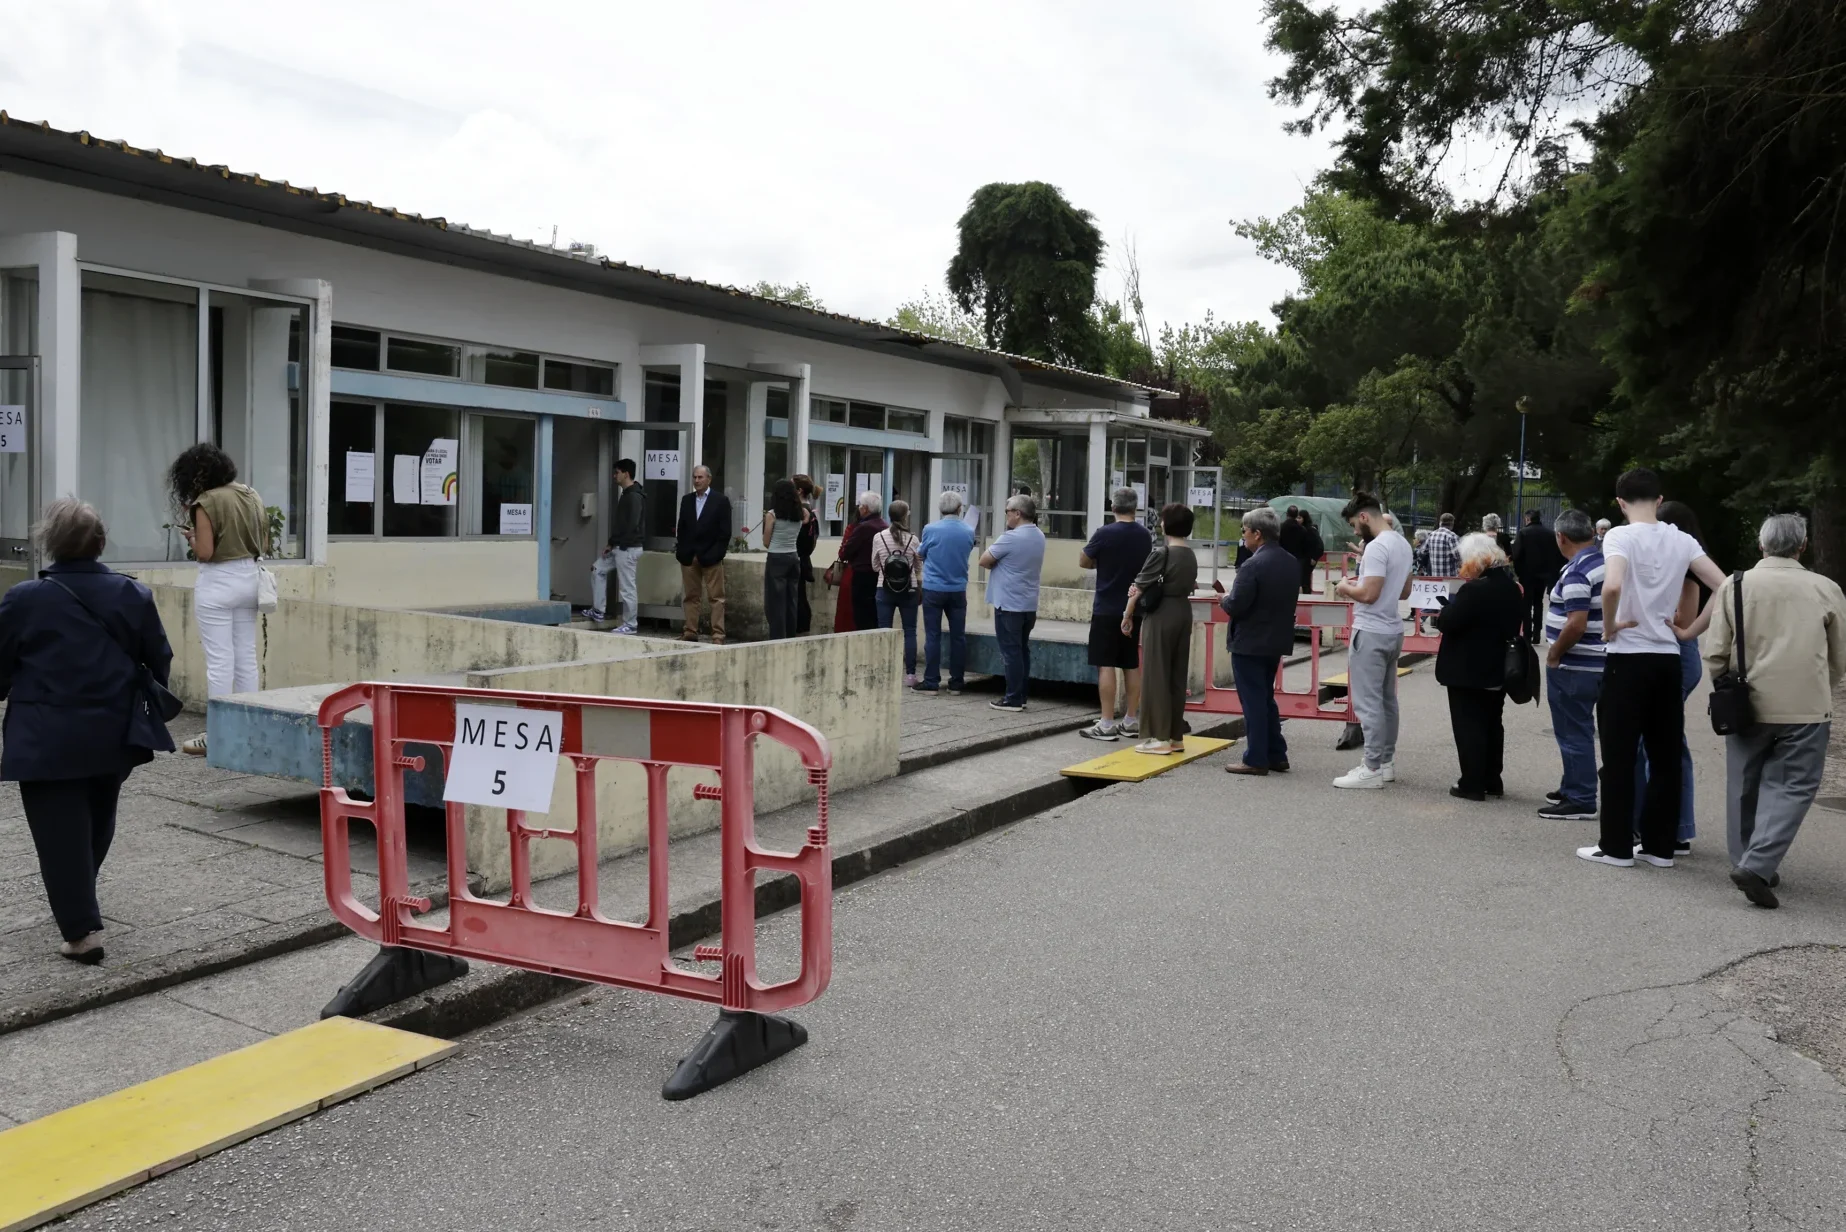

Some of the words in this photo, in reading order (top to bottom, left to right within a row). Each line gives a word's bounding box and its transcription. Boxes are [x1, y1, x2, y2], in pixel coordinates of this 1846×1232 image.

[1, 434, 7, 447] 5
[647, 453, 679, 463] MESA
[660, 468, 665, 476] 6
[943, 485, 967, 493] MESA
[1190, 489, 1212, 497] MESA
[1412, 584, 1447, 593] MESA
[1426, 597, 1431, 605] 7
[462, 717, 553, 752] MESA
[491, 769, 507, 795] 5
